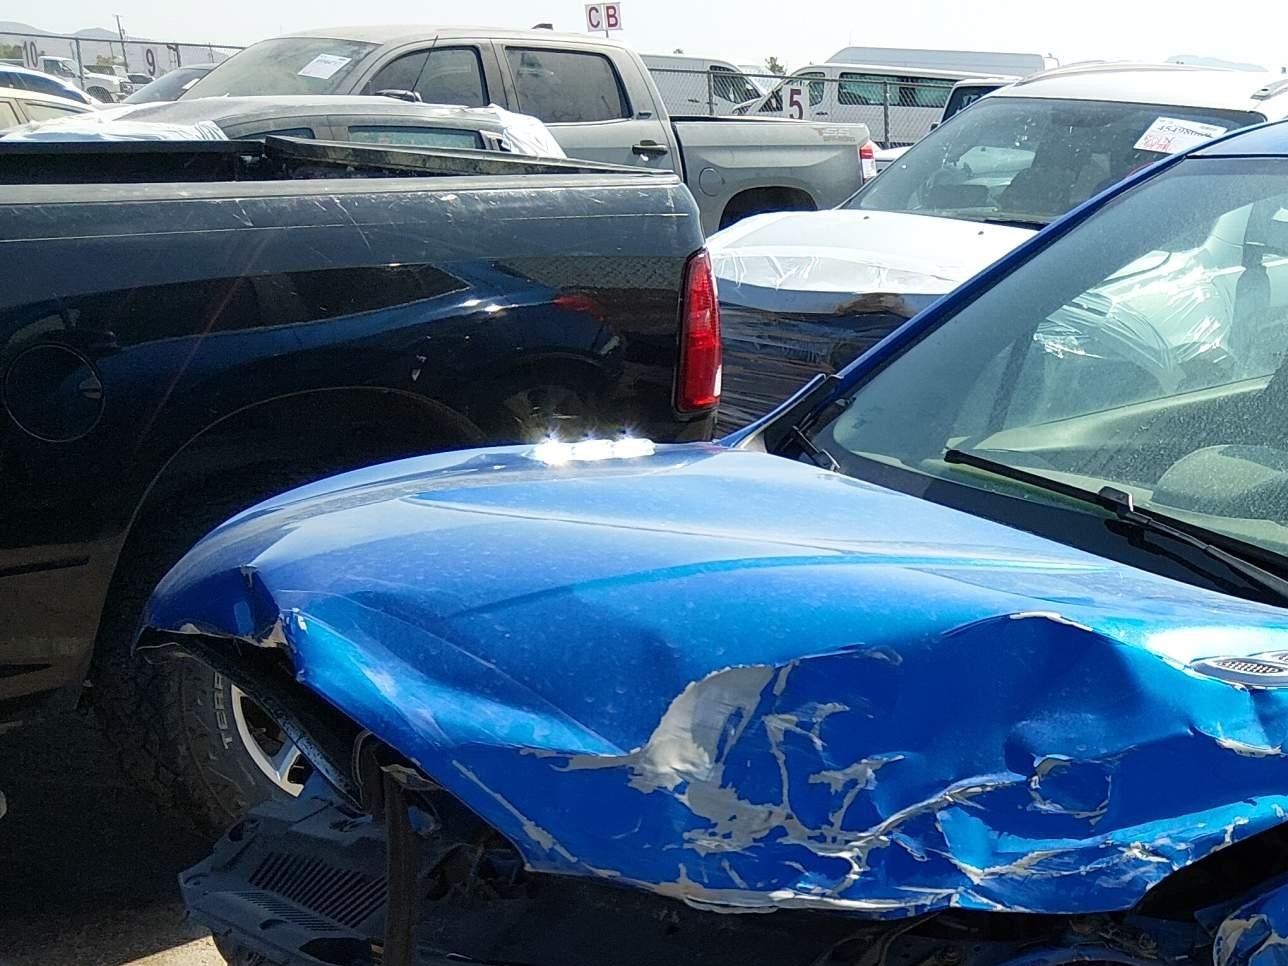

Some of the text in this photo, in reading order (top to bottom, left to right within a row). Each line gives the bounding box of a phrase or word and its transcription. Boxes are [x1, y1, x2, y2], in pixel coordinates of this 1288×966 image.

[23, 39, 39, 69] 10
[145, 48, 157, 77] 9
[789, 88, 804, 120] 5
